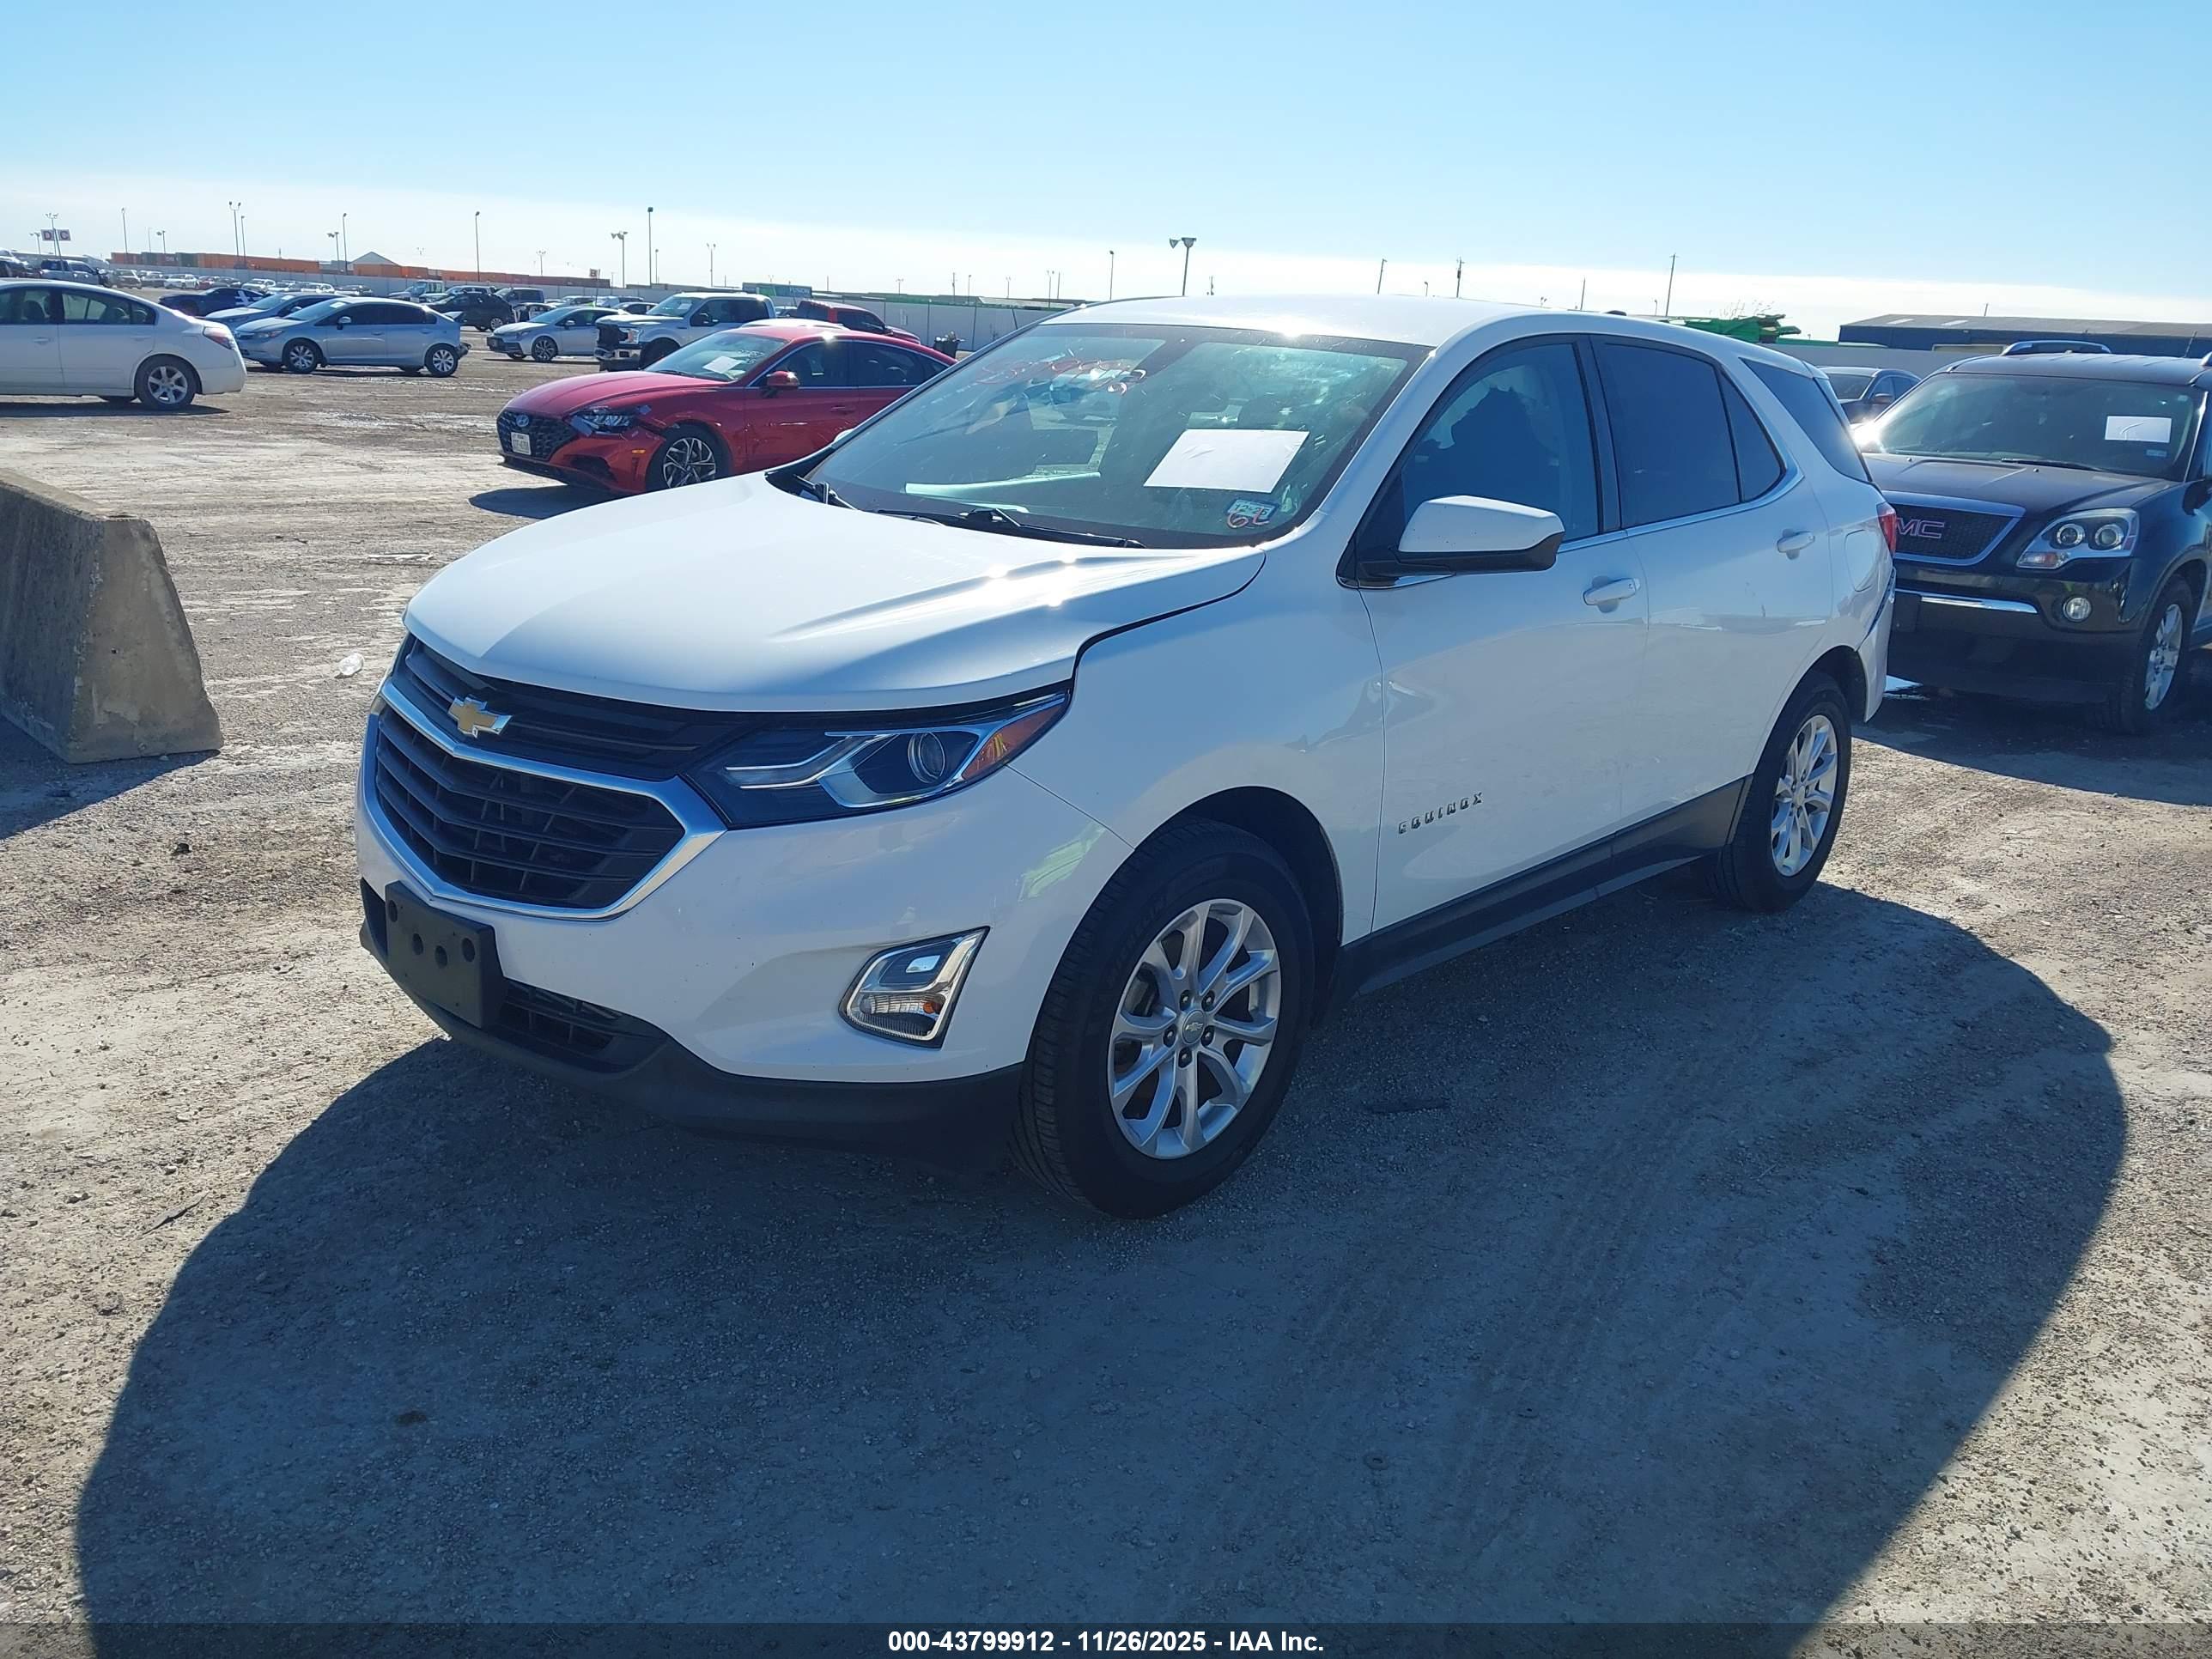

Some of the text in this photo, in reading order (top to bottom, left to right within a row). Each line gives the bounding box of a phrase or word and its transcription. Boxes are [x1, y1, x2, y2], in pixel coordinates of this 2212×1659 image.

[43, 230, 52, 240] D
[59, 230, 69, 240] C
[1896, 517, 1945, 539] MC
[1397, 792, 1483, 835] EQUINOX
